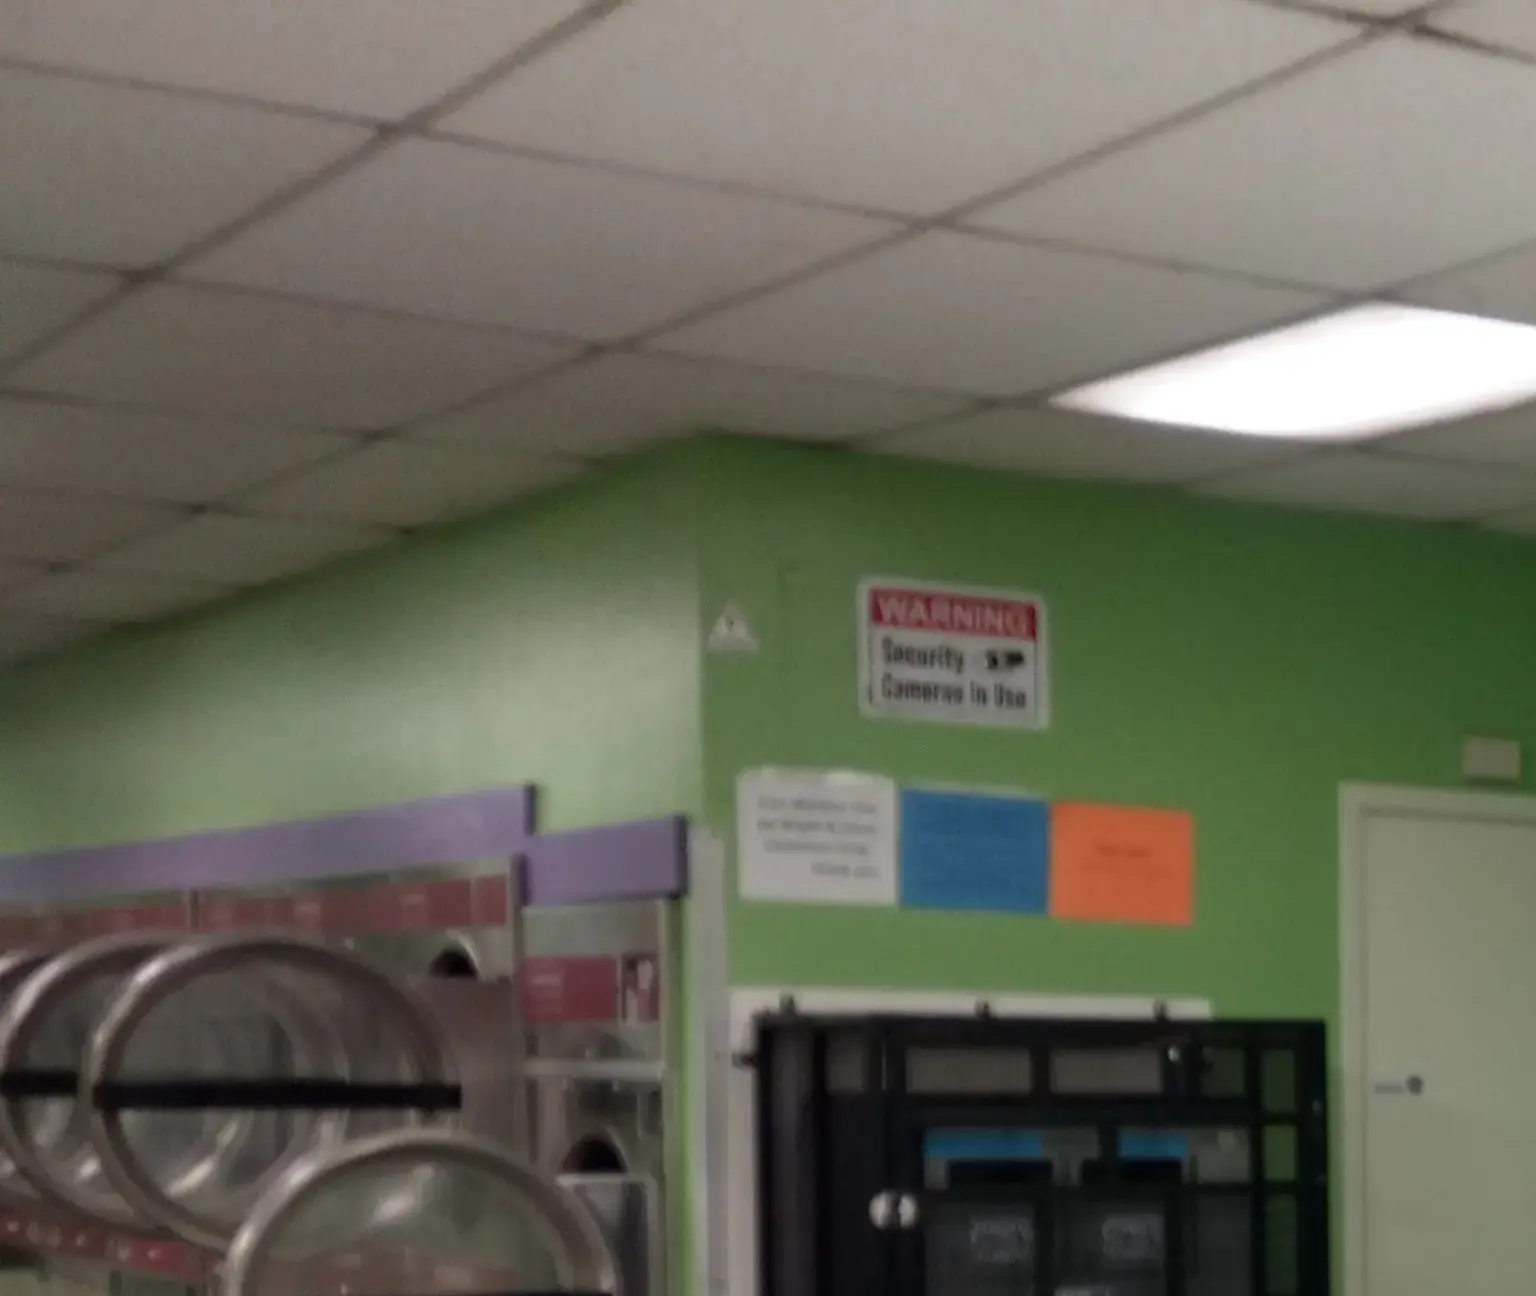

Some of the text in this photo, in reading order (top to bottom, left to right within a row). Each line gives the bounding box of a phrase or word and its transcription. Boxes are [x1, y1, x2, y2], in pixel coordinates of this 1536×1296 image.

[878, 596, 1028, 636] WARNING
[882, 635, 963, 674] Security
[882, 672, 1027, 709] Cameras in Use
